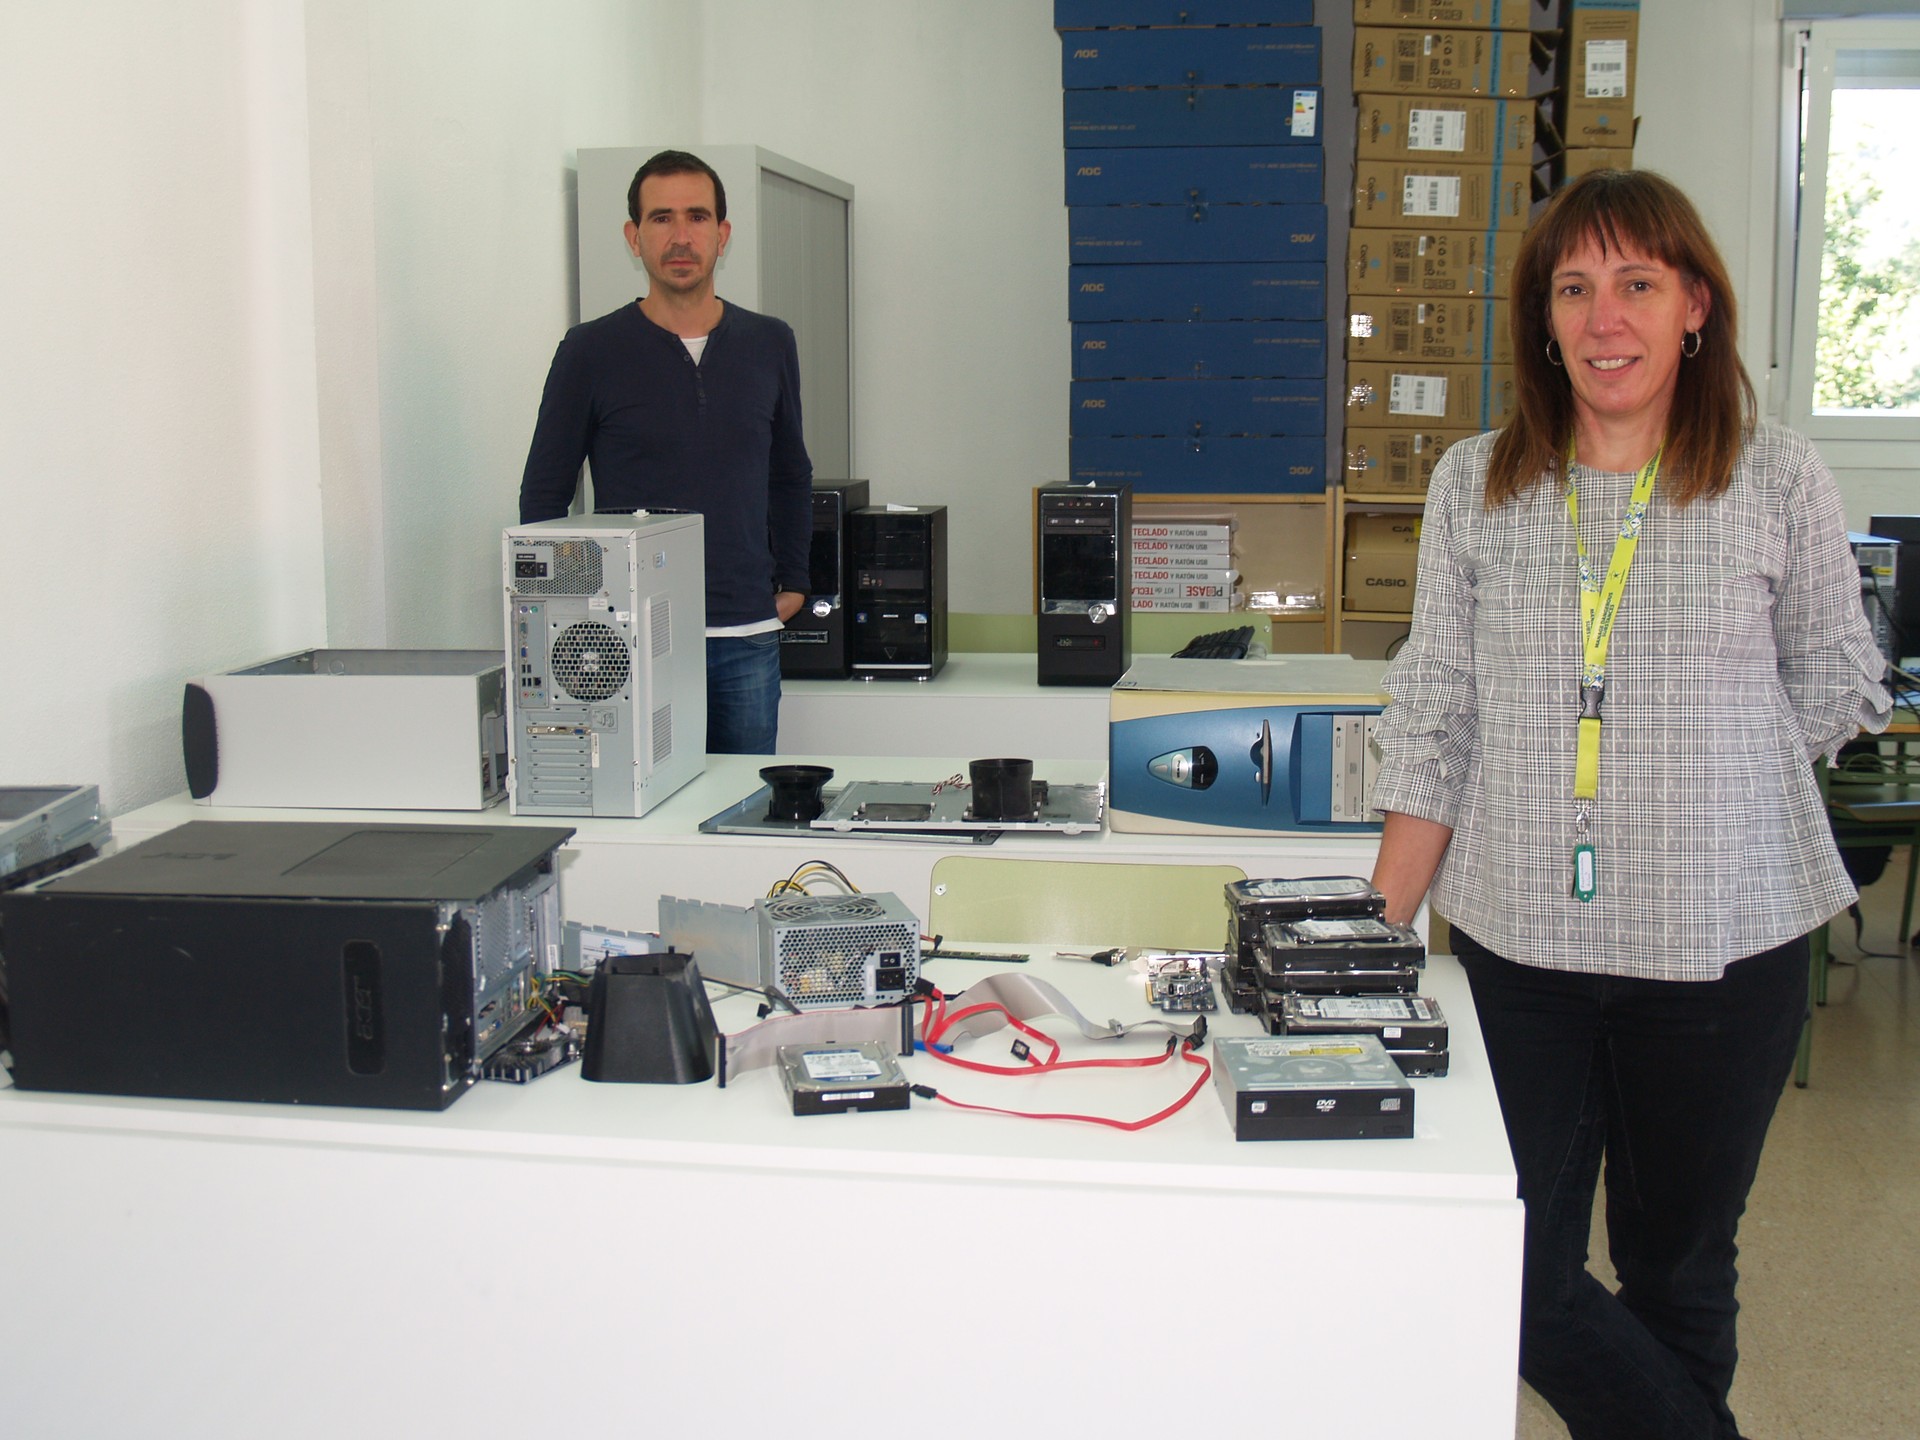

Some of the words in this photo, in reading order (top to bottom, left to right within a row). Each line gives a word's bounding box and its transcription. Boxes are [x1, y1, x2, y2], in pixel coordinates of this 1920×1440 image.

[1074, 49, 1098, 58] AOC
[1364, 42, 1374, 77] CoolBox
[1371, 109, 1380, 143] CoolBox
[1582, 126, 1618, 136] CoolBox
[1077, 167, 1101, 176] AOC
[1367, 177, 1376, 211] CoolBox
[1291, 234, 1315, 243] AOC
[1360, 244, 1368, 279] CoolBox
[1080, 283, 1104, 292] AOC
[1082, 341, 1107, 350] AOC
[1081, 399, 1106, 408] AOC
[1289, 466, 1314, 475] AOC
[1133, 528, 1168, 536] TECLADO
[1133, 542, 1168, 550] TECLADO
[1133, 557, 1168, 565] TECLADO
[1134, 572, 1168, 580] TECLADO
[1365, 578, 1407, 588] CASIO
[1132, 587, 1153, 595] TECLA
[1132, 600, 1153, 608] LADO
